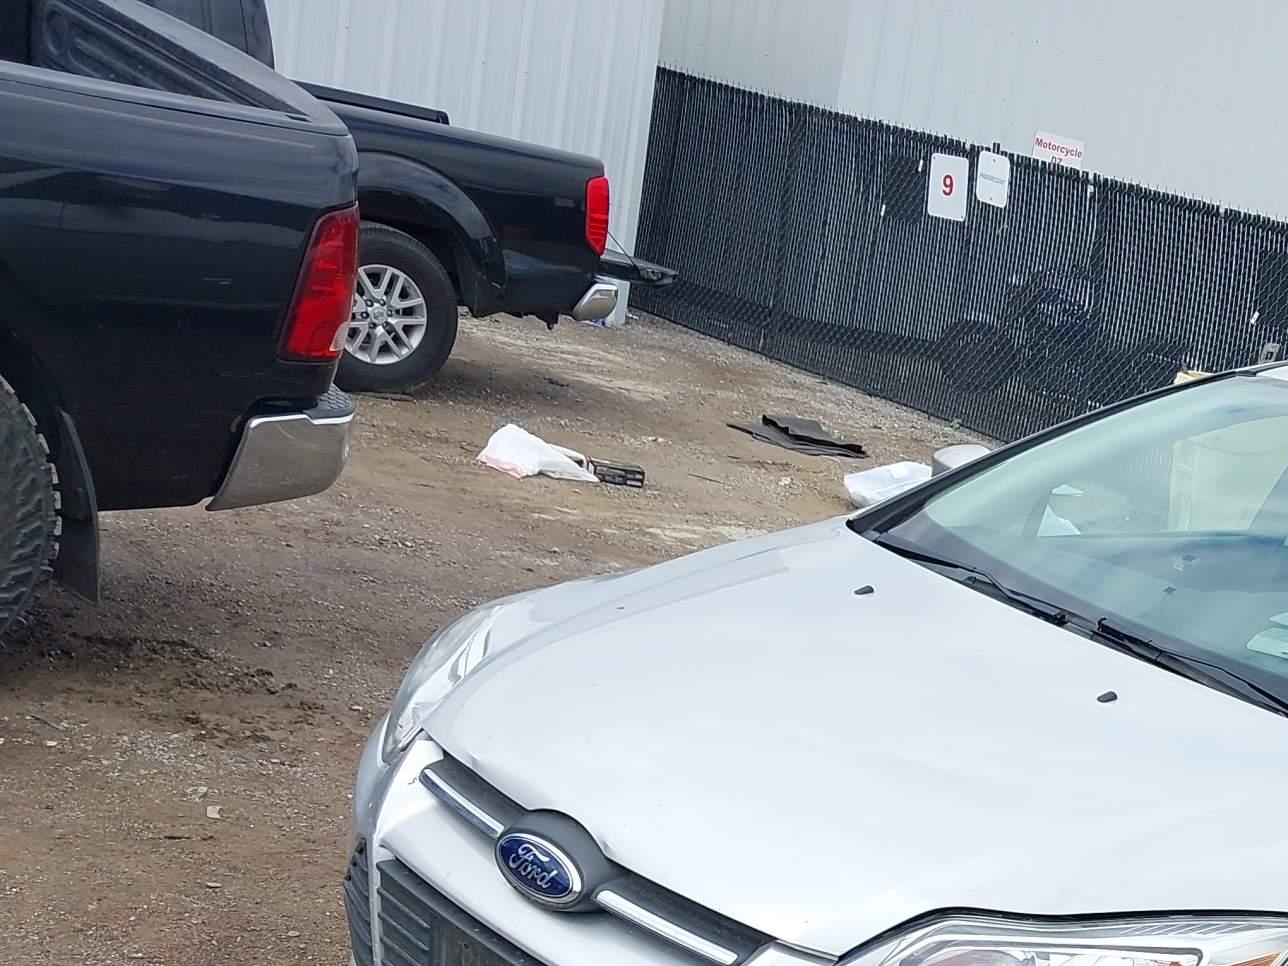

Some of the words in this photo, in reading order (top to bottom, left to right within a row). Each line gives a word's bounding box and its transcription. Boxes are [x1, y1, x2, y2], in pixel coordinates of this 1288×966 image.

[1034, 137, 1083, 158] Motorcycle
[942, 174, 954, 195] 9
[508, 843, 558, 889] Ford
